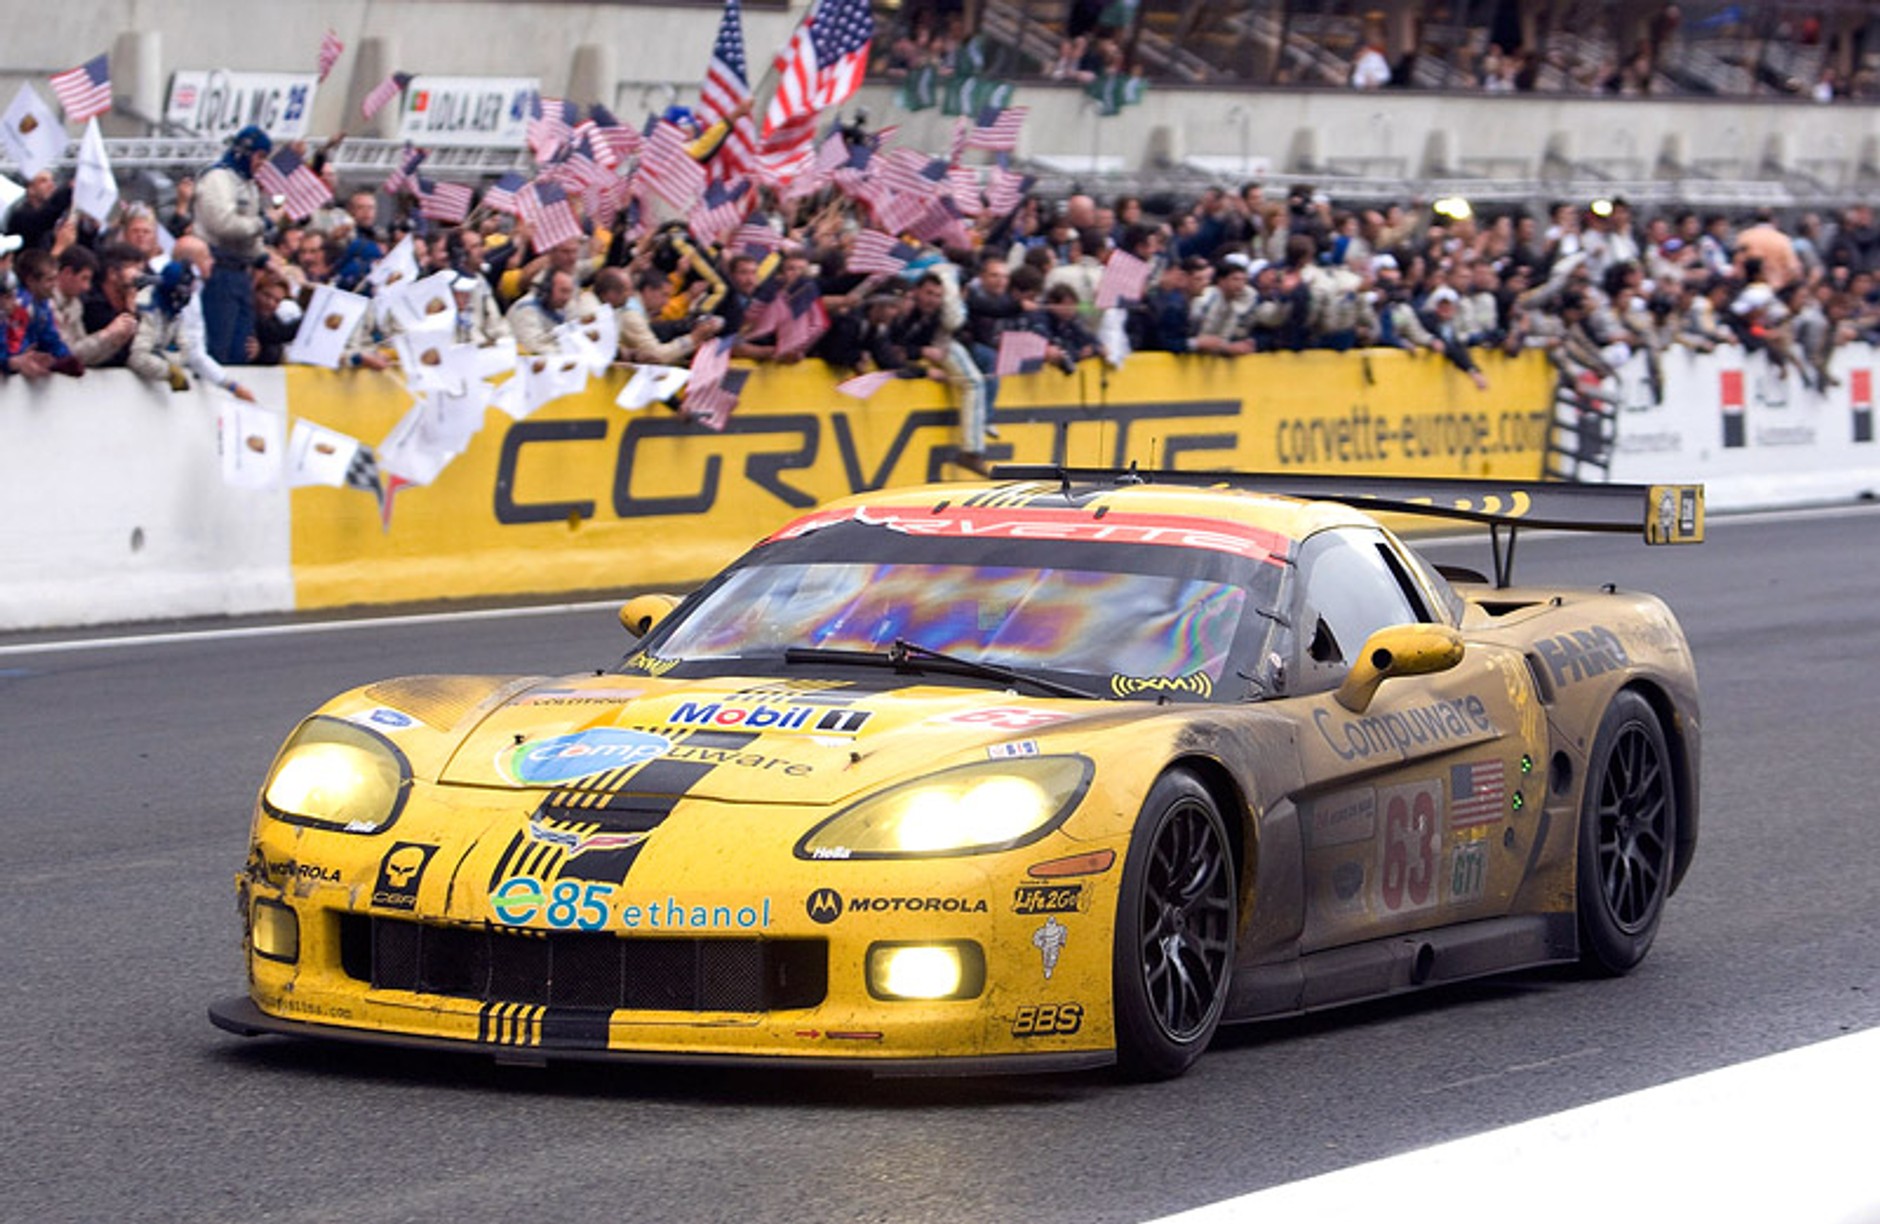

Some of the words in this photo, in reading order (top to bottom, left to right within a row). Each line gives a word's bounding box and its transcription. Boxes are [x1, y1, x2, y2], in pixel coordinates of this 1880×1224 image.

[668, 702, 814, 729] Mobil
[1312, 694, 1490, 760] Compuware
[1382, 790, 1436, 911] 63
[622, 897, 771, 927] ethanol
[848, 897, 989, 913] MOTOROLA
[1011, 1003, 1084, 1037] BBS
